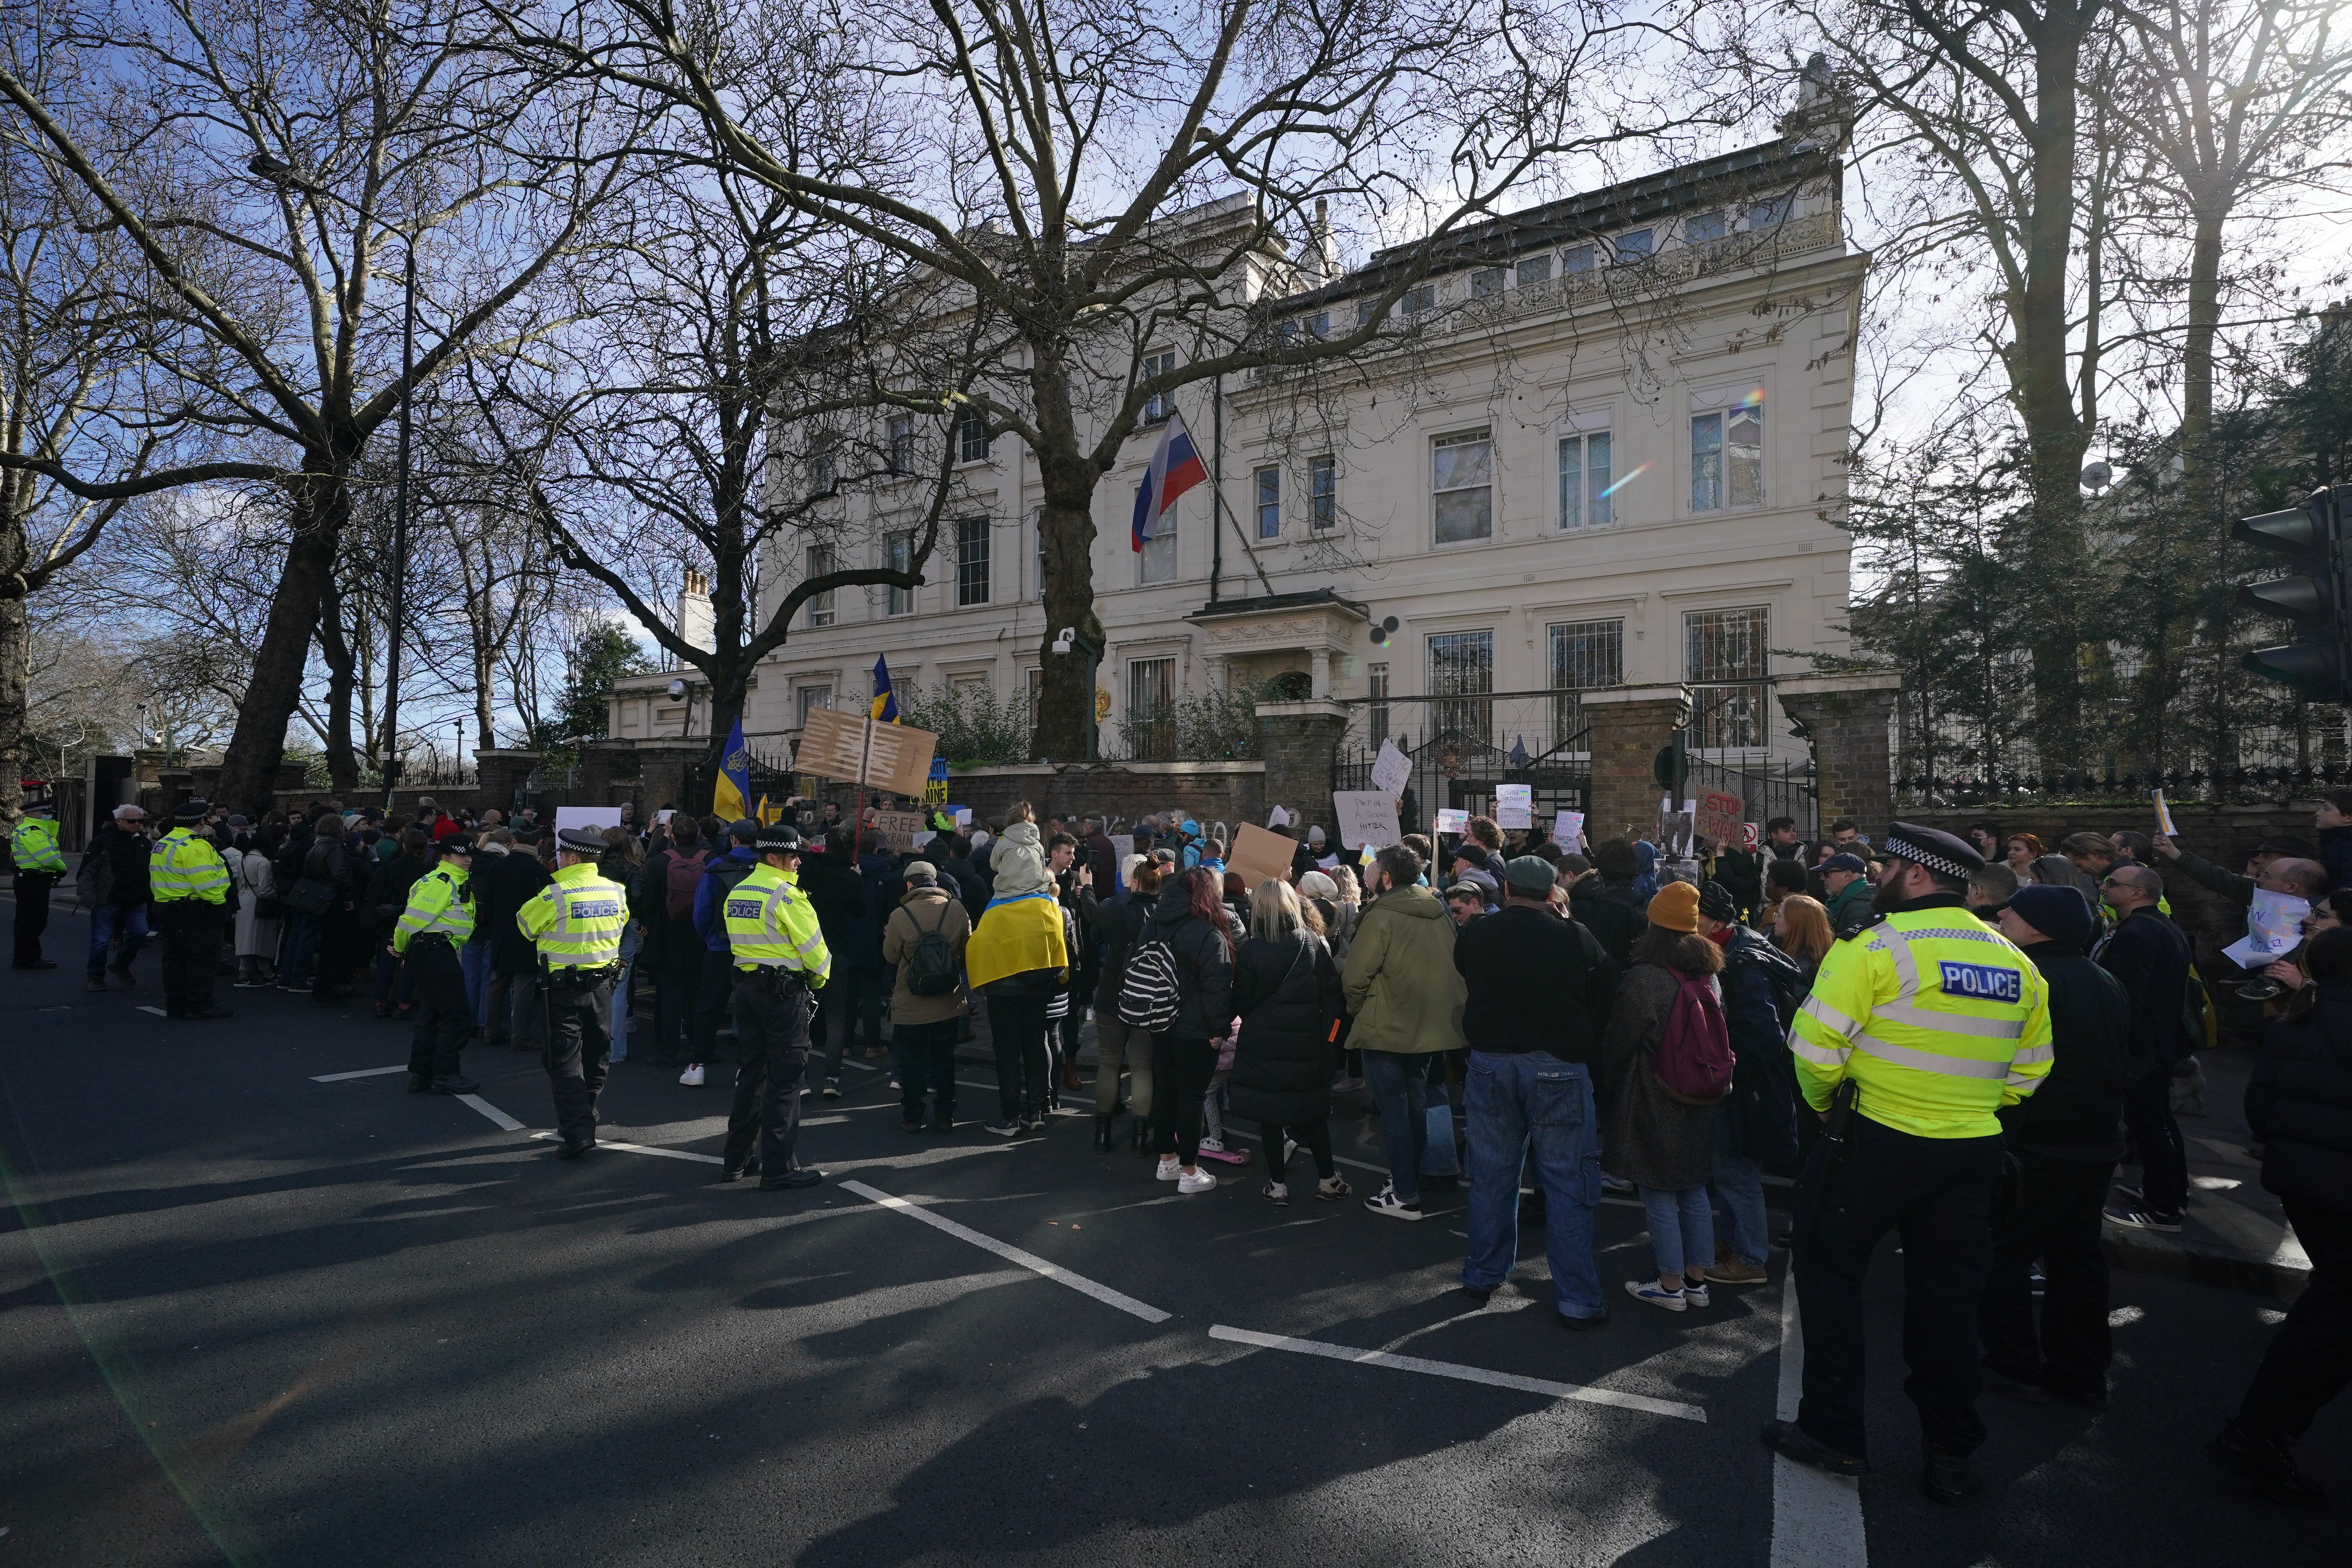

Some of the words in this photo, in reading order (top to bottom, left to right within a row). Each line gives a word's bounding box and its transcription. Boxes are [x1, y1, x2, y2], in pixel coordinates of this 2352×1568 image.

[927, 777, 942, 788] ITH
[1707, 794, 1740, 817] STOP
[879, 816, 917, 832] FREE
[1360, 822, 1388, 831] HITLER
[1709, 816, 1738, 845] WAR
[884, 832, 913, 846] KRAIN
[573, 906, 617, 917] POLICE
[728, 906, 760, 917] POLICE
[1945, 967, 2018, 998] POLICE
